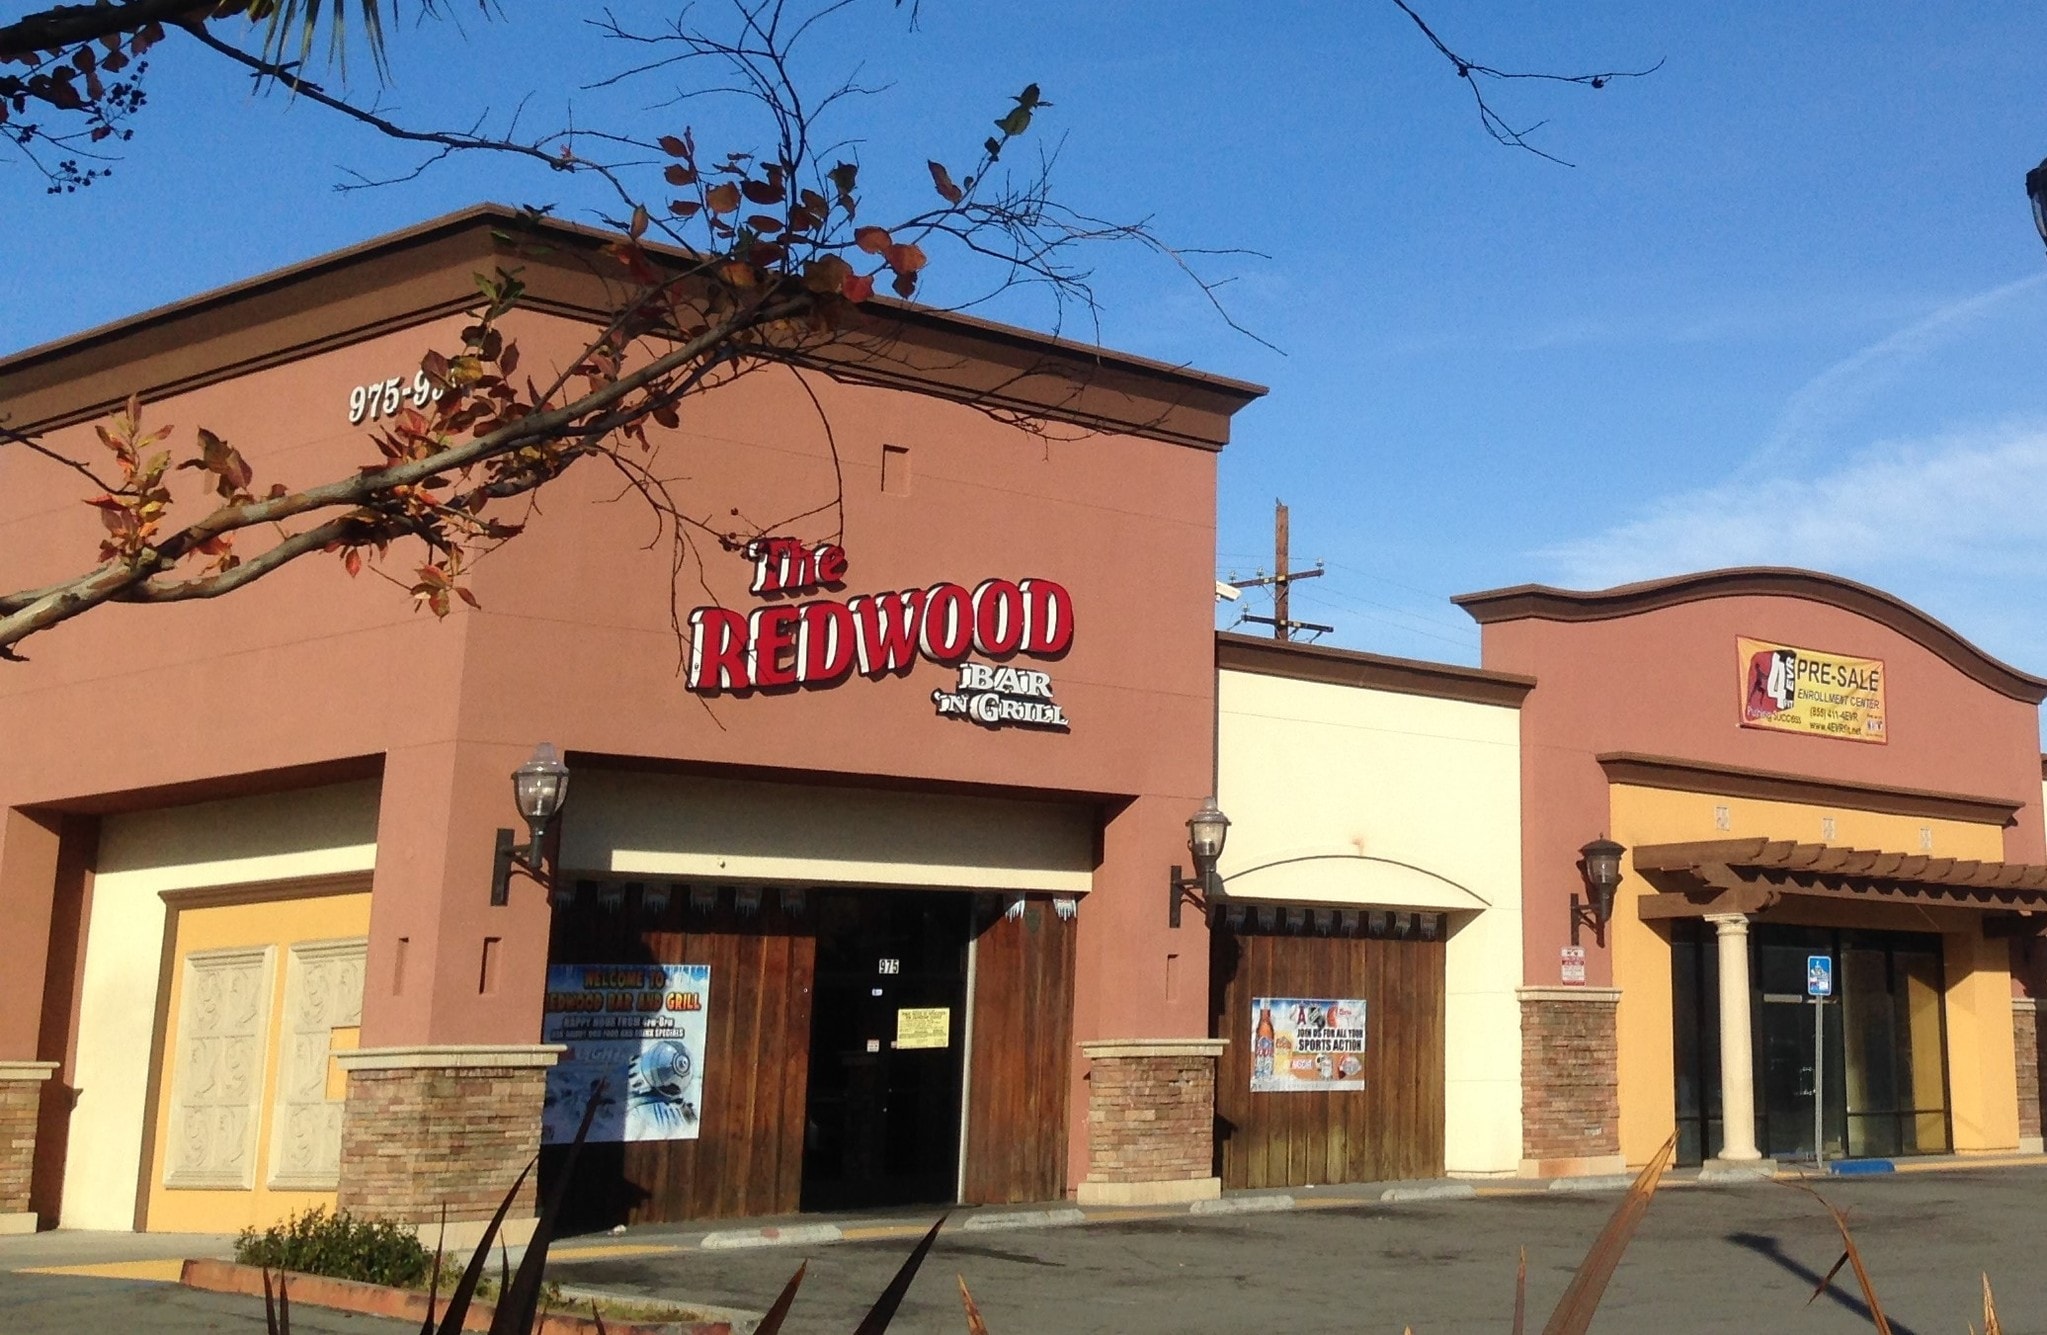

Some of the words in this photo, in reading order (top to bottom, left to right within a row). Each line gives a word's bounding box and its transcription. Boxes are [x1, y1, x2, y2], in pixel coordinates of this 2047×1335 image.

[748, 538, 848, 592] The
[688, 579, 1073, 690] REDWOOD
[957, 662, 1053, 698] BAR
[1797, 659, 1880, 692] PRE-SALE
[971, 692, 1071, 726] GRILL
[1797, 688, 1849, 706] ENROLLMENT
[1849, 696, 1880, 710] CENTER
[880, 960, 899, 973] 975
[584, 971, 645, 988] WELCOME
[649, 971, 666, 988] TO
[546, 992, 603, 1012] EDWOOD
[606, 992, 633, 1012] BAR
[637, 992, 663, 1011] AND
[666, 992, 702, 1011] GRILL
[1297, 1029, 1312, 1038] JOIN
[1312, 1029, 1322, 1038] US
[1323, 1029, 1335, 1038] FOR
[1336, 1029, 1347, 1038] ALL
[1348, 1029, 1363, 1038] YOUR
[1298, 1040, 1332, 1051] SPORTS
[1333, 1040, 1362, 1051] ACTION
